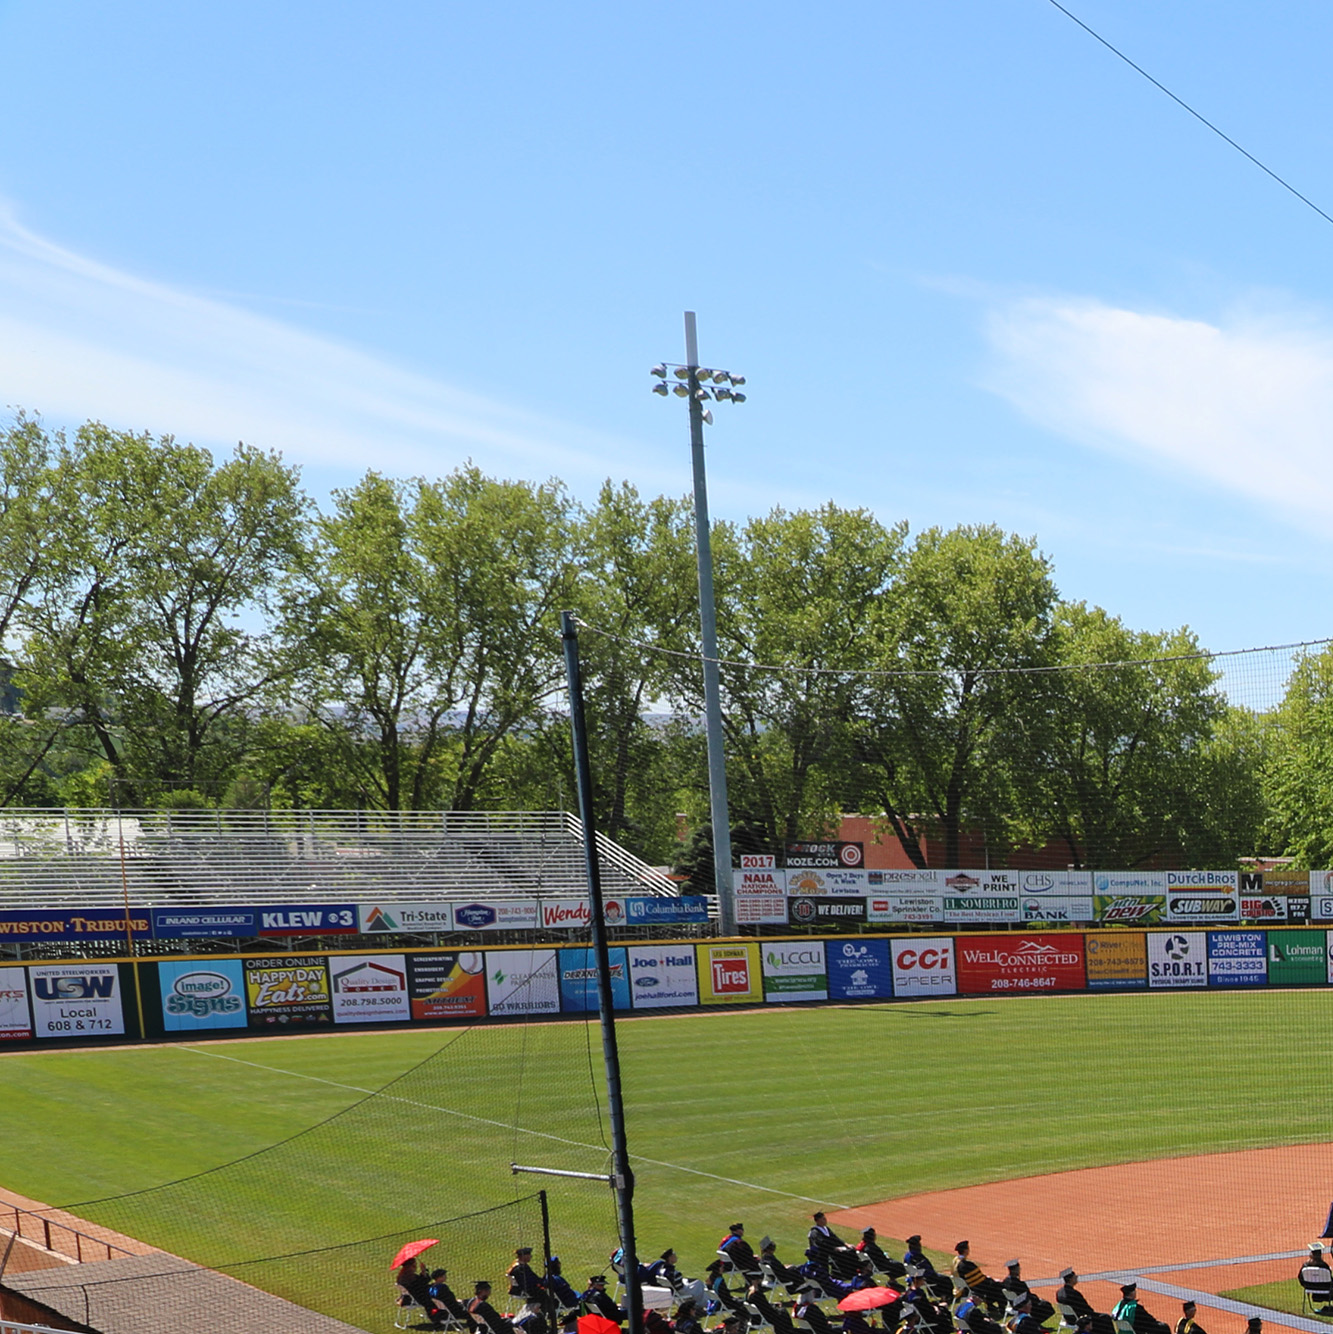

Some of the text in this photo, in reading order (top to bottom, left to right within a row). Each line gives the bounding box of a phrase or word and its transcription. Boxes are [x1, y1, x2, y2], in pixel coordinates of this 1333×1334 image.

[743, 857, 774, 867] 2017
[786, 857, 839, 866] KOZE.COM
[744, 873, 774, 883] NAIA
[991, 874, 1008, 883] WE
[1025, 874, 1052, 887] CHS
[983, 883, 1017, 892] PRINT
[646, 902, 705, 914] Columbia Bank
[818, 904, 864, 915] WE DELIVER!
[892, 905, 942, 914] Sprinkler Co.
[961, 897, 1018, 910] SOMBRERO
[1173, 899, 1234, 914] SUBWAY
[1241, 900, 1262, 910] BIG
[262, 910, 353, 928] KLEW 3
[400, 910, 447, 922] Tri-State
[1024, 911, 1069, 920] BANK
[71, 917, 149, 932] TRIBUNE
[1211, 934, 1262, 942] LEWISTON
[1217, 941, 1257, 949] PRE-MIX
[1286, 944, 1323, 956] Lohman
[246, 957, 326, 969] ORDER ONLINE
[632, 955, 693, 968] Joe Hall
[781, 951, 821, 965] LCCU
[1151, 962, 1205, 977] S.P.O.R.T.
[1212, 961, 1264, 971] 743-3333
[713, 963, 747, 990] Tires
[896, 976, 953, 987] SPEER
[33, 975, 115, 1001] USW
[180, 980, 225, 993] image!
[991, 977, 1056, 989] 208-746-8647
[167, 994, 242, 1018] Signs
[292, 1004, 330, 1013] DELIVERED
[60, 1007, 97, 1018] Local
[47, 1019, 112, 1031] 608 & 712
